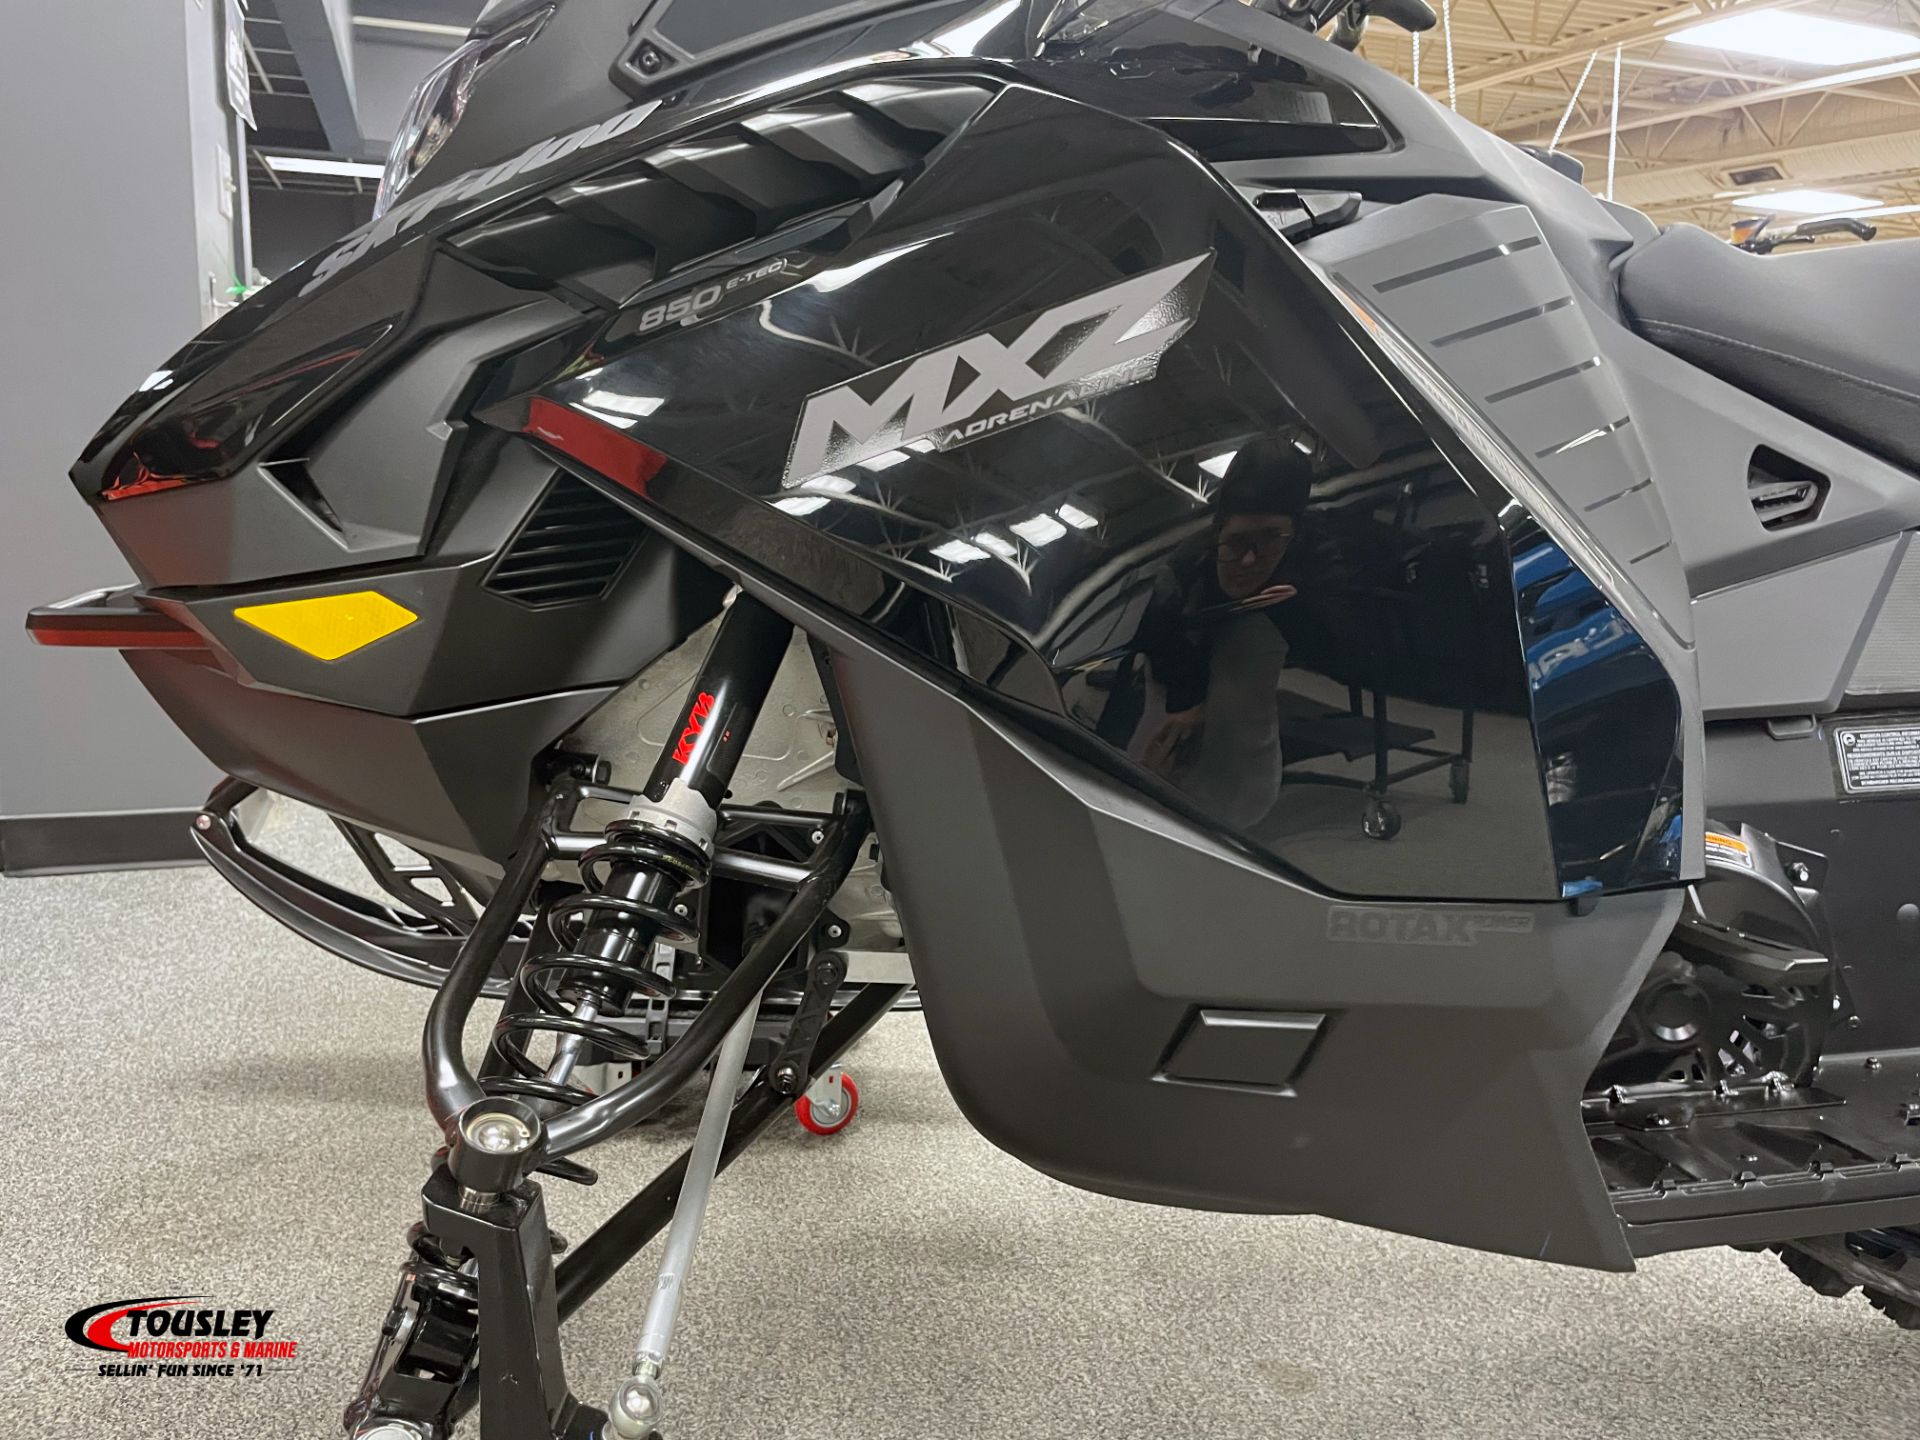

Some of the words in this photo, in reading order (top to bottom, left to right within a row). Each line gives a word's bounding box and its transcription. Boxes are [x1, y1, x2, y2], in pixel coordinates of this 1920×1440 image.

[638, 285, 722, 332] 850
[726, 258, 787, 290] E-TEC
[785, 251, 1212, 486] MXZ
[941, 365, 1156, 446] ADRENALINE
[1329, 910, 1472, 942] ROTAX
